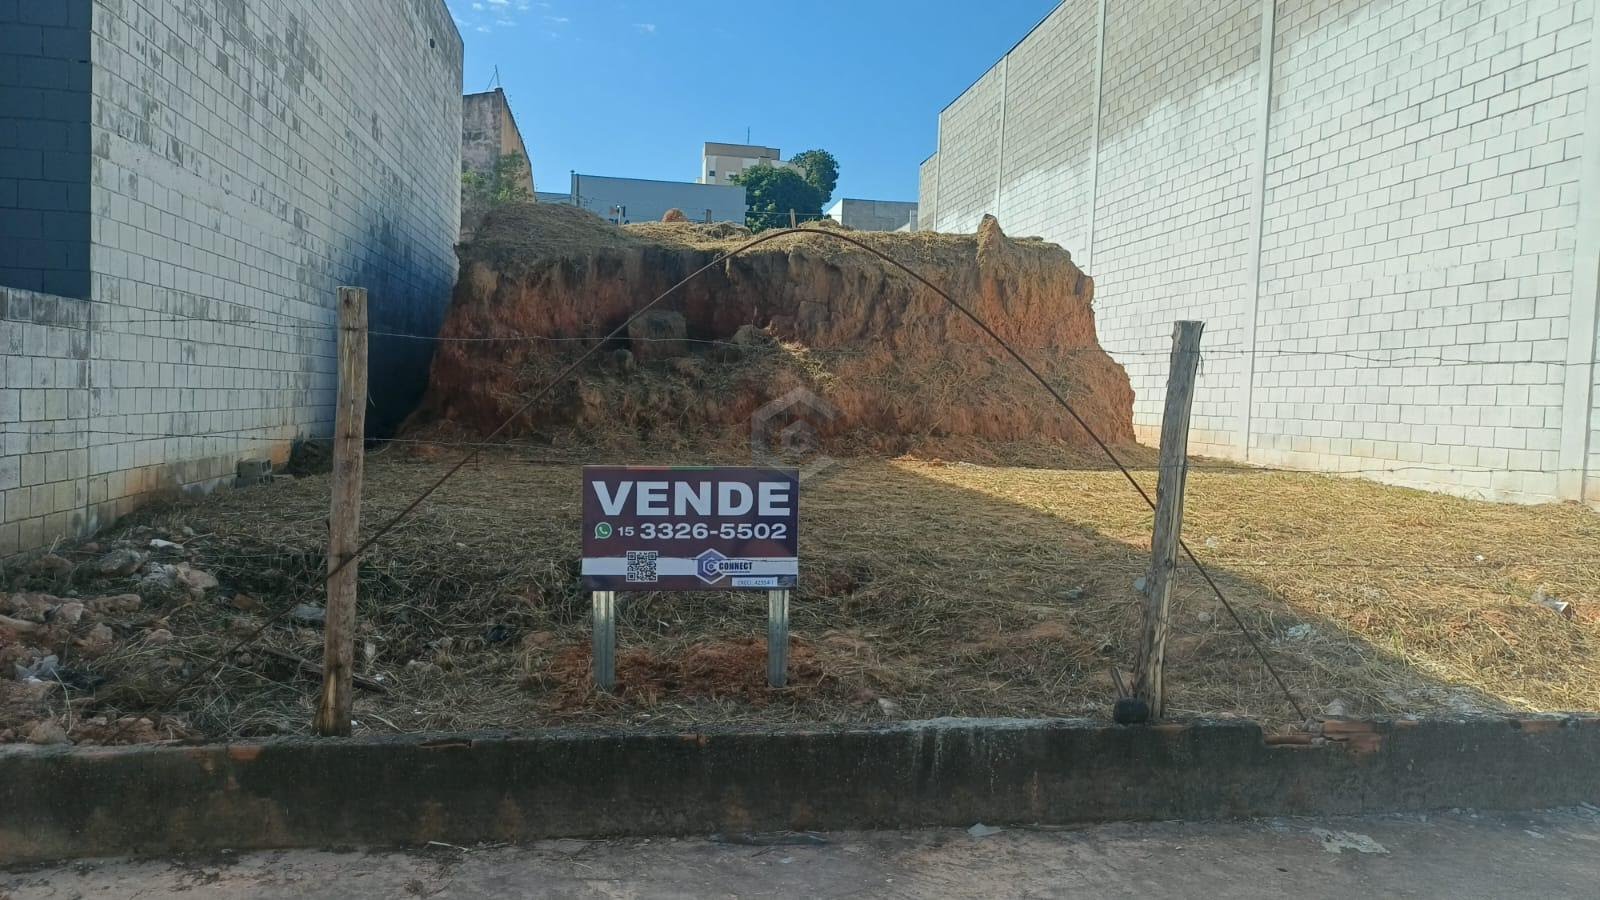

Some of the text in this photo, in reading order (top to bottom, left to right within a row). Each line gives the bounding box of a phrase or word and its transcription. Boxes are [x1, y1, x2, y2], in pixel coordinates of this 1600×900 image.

[592, 481, 790, 516] VENDE
[618, 523, 787, 539] 15 3326-5502
[718, 562, 753, 570] CONNECT
